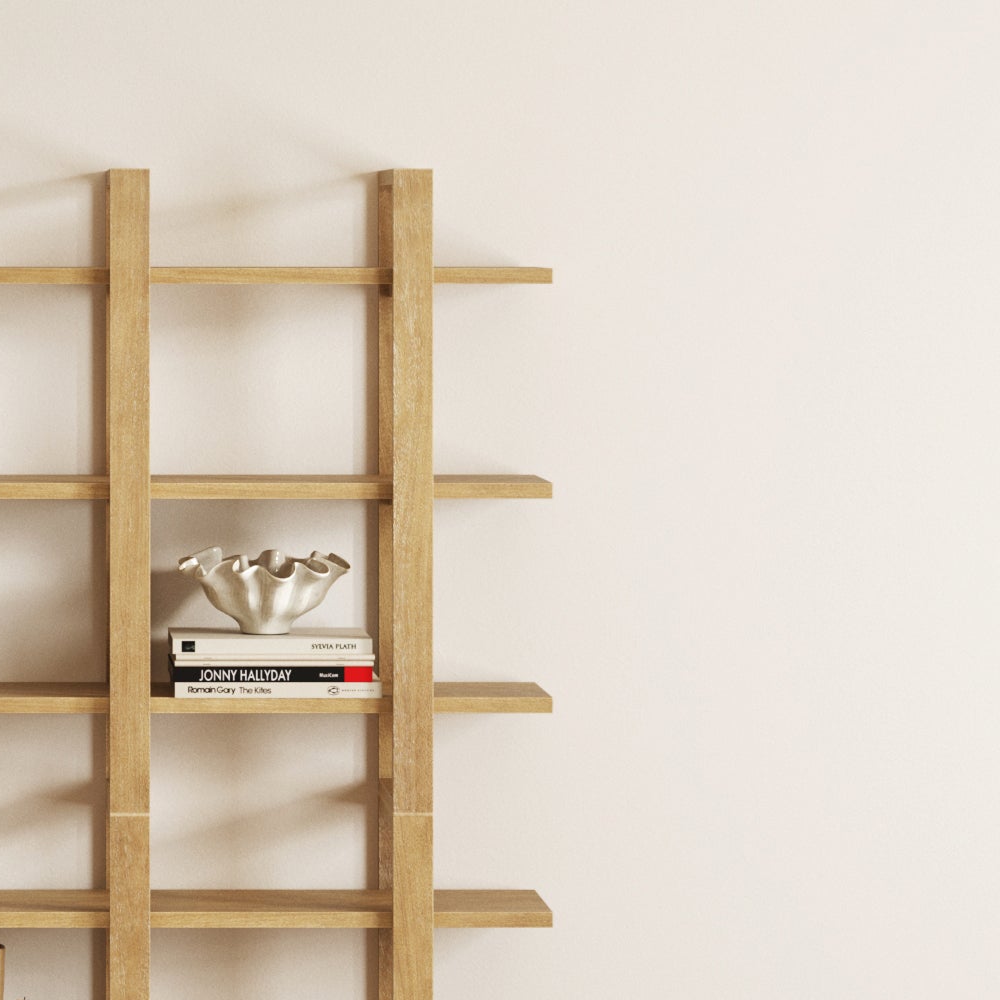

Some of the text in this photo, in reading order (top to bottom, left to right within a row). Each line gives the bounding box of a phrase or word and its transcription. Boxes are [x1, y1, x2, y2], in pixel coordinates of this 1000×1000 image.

[199, 669, 292, 682] JONNY HALLYDAY
[187, 686, 272, 695] Romain Gary The Kites
